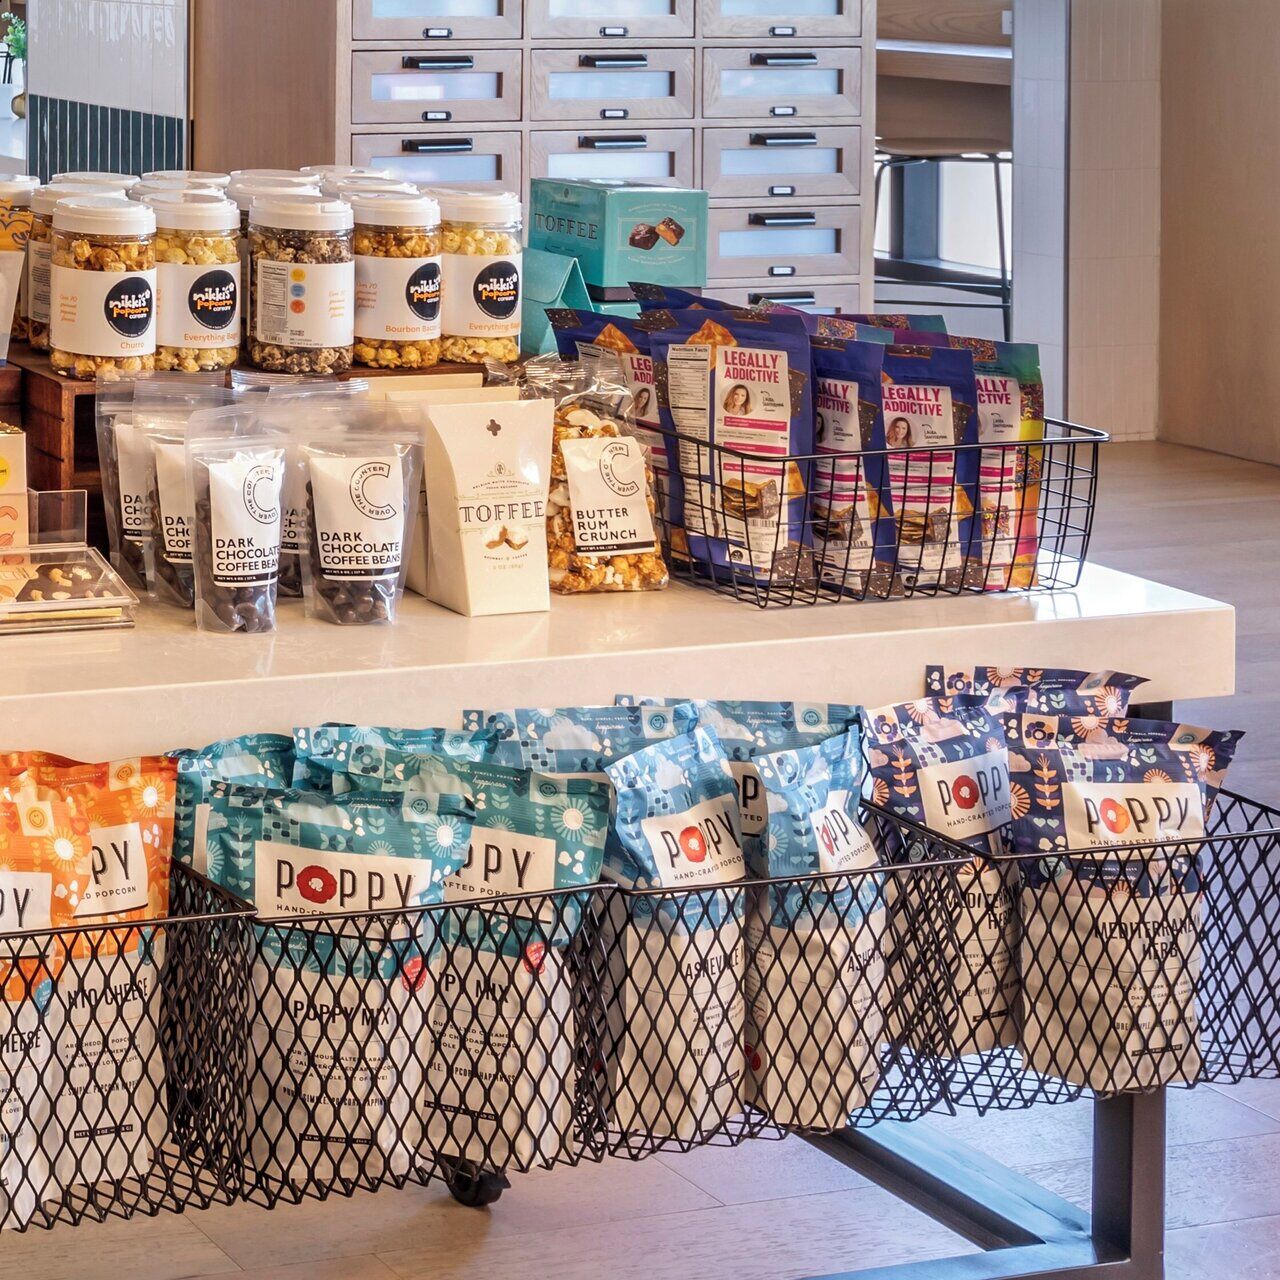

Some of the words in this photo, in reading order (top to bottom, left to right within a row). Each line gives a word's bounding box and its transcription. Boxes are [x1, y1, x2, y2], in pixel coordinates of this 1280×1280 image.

[534, 213, 599, 240] TOFFEE
[482, 290, 517, 301] popcorn
[197, 299, 233, 311] popcorn
[113, 307, 150, 318] popcorn
[385, 324, 421, 334] Bourbon
[468, 322, 510, 331] Everything
[184, 333, 226, 343] Everything
[120, 341, 145, 350] Churro
[723, 350, 779, 369] LEGALLY
[723, 367, 780, 384] ADDICTIVE
[881, 385, 941, 403] LEGALLY
[883, 400, 943, 417] ADDICTIVE
[458, 500, 545, 523] TOFFEE
[576, 507, 629, 520] BUTTER
[577, 520, 609, 531] RUM
[216, 536, 255, 549] DARK
[321, 531, 363, 543] DARK
[579, 530, 638, 542] CRUNCH
[216, 544, 280, 560] CHOCOLATE
[322, 541, 400, 555] CHOCOLATE
[216, 560, 259, 572] COFFEE
[323, 553, 370, 566] COFFEE
[372, 553, 401, 565] BEANS
[1083, 795, 1190, 833] POPPY
[660, 809, 741, 869] POPPY
[275, 858, 415, 911] POPPY
[95, 885, 137, 899] POPCORN
